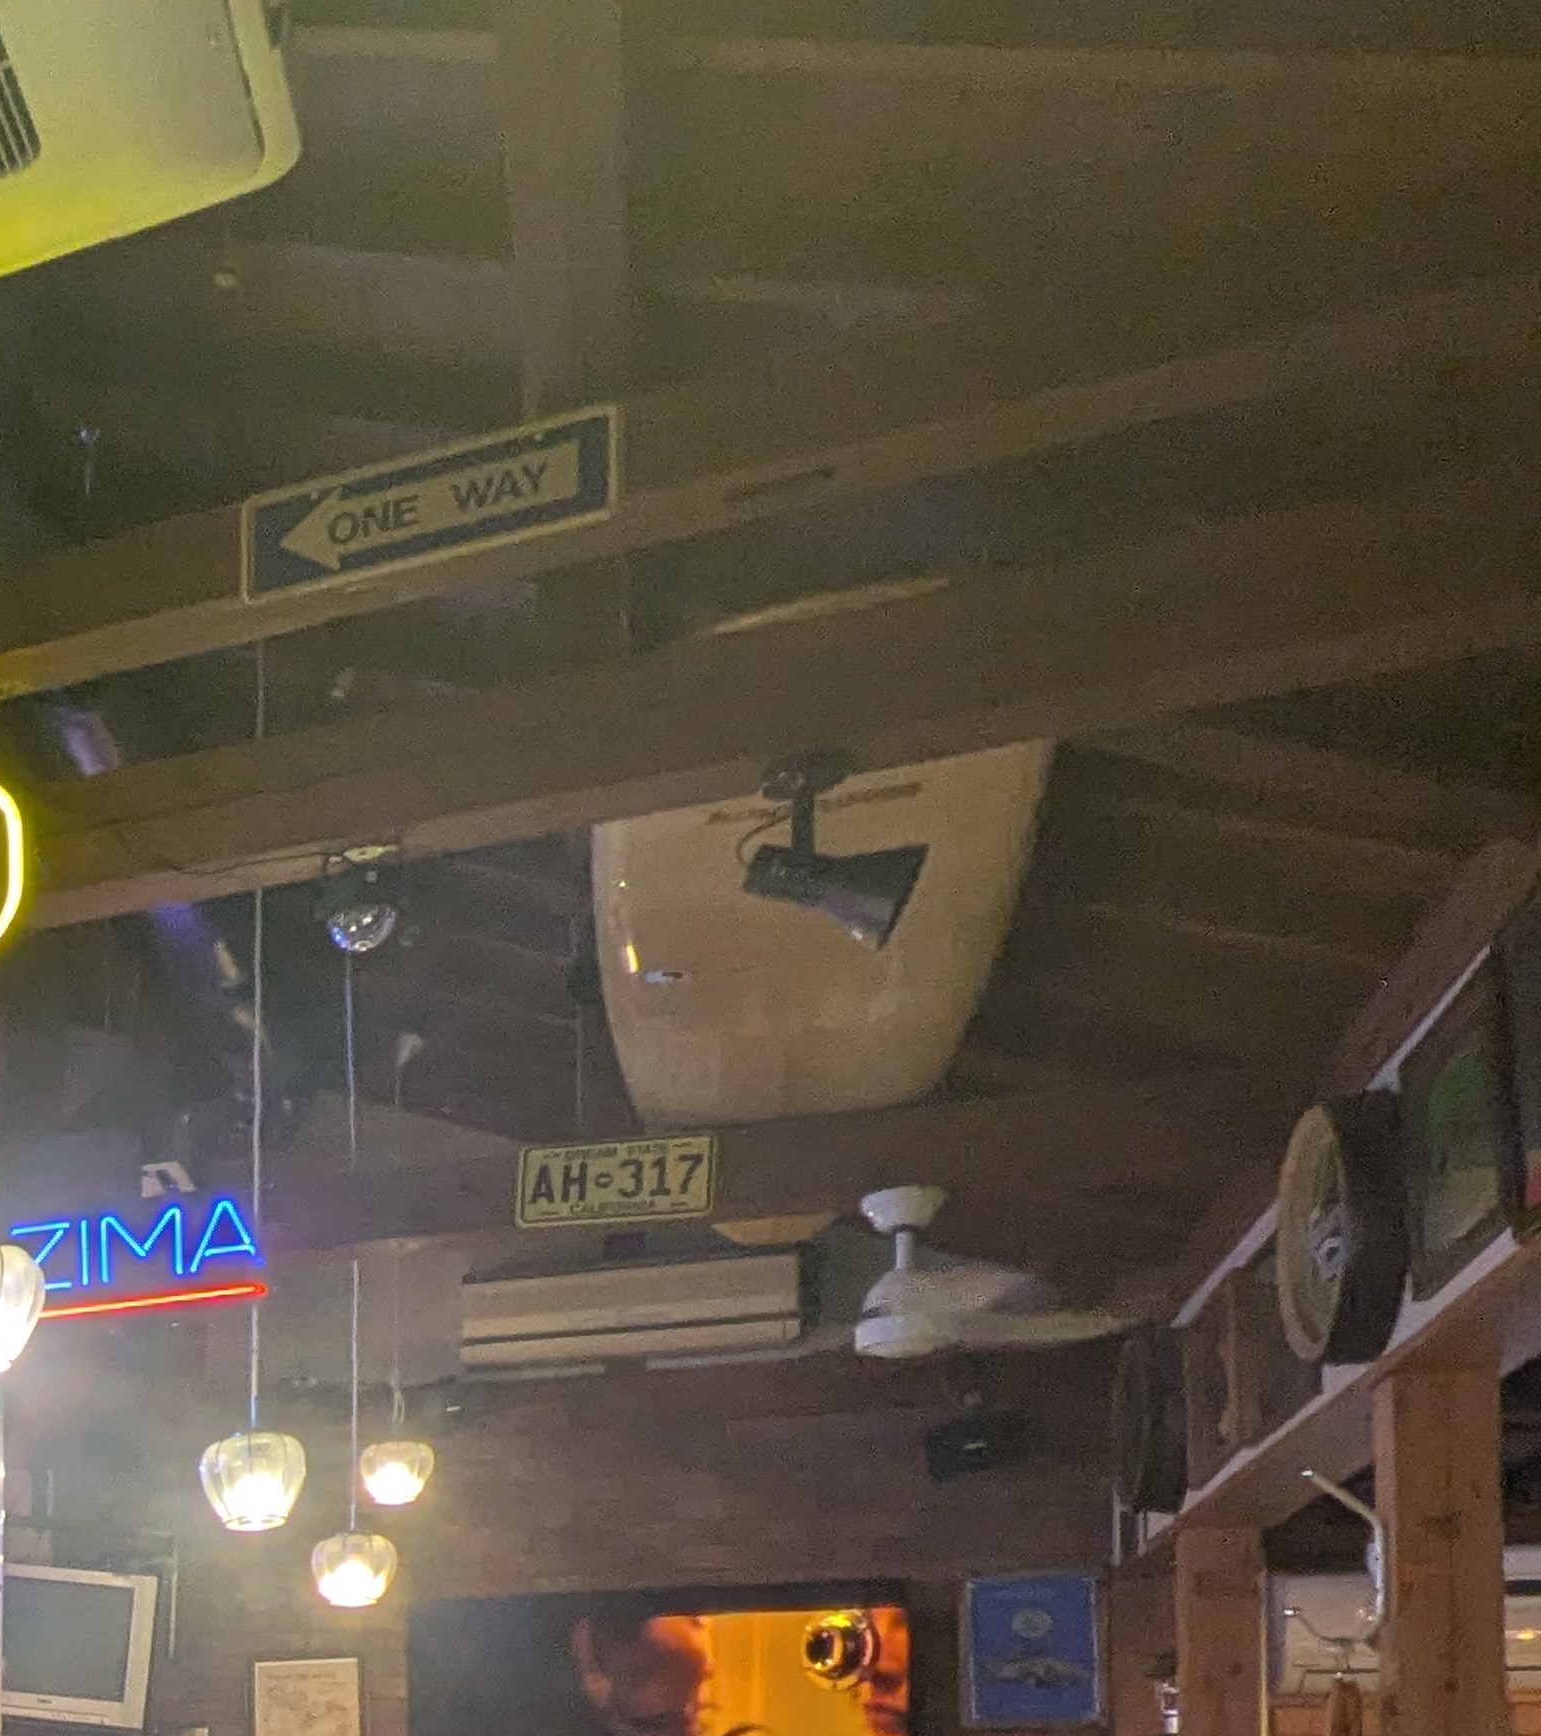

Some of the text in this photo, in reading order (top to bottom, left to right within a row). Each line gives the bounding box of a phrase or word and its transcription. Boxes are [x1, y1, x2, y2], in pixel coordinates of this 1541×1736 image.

[327, 461, 550, 546] ONE WAY
[9, 1196, 266, 1291] ZIMA
